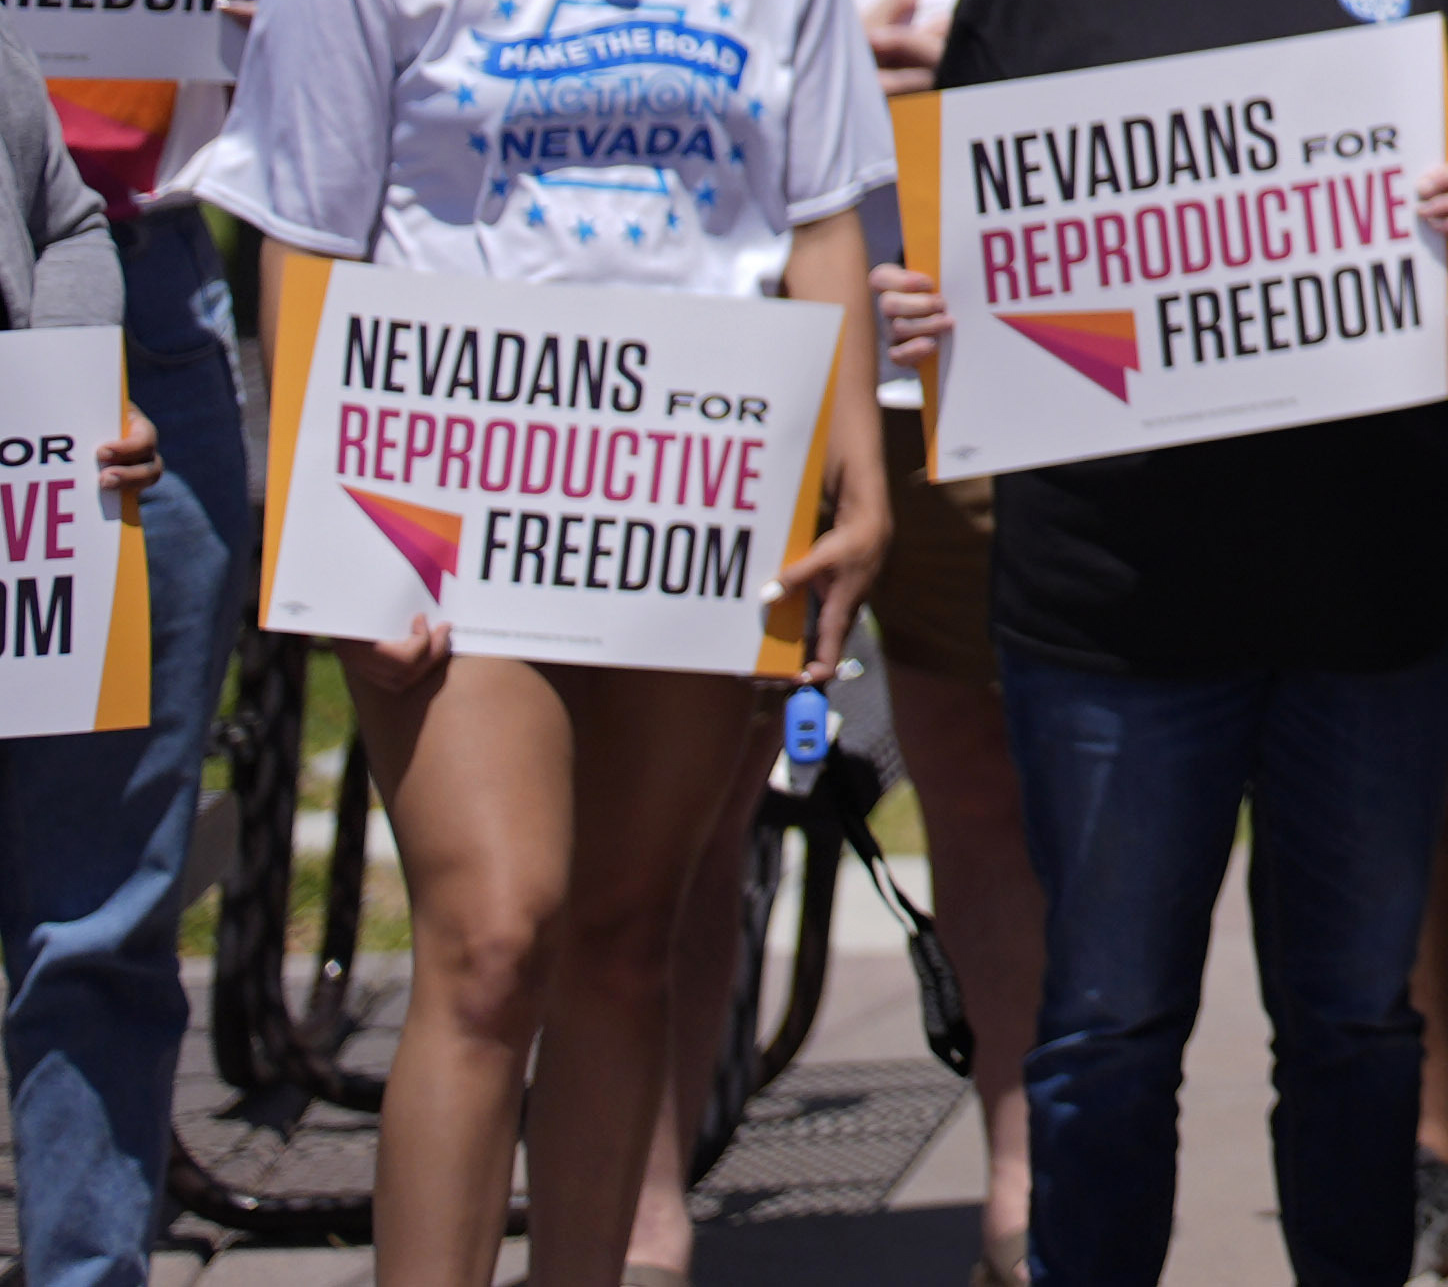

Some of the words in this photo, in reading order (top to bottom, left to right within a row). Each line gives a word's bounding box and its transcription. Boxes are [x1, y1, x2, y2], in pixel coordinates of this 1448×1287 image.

[499, 39, 590, 71] MAKE
[589, 27, 652, 59] THE
[655, 29, 741, 75] ROAD
[505, 74, 731, 121] ACTION
[501, 124, 715, 163] NEVADA
[970, 97, 1280, 215] NEVADANS
[1302, 125, 1400, 164] FOR
[980, 164, 1410, 304] REPRODUCTIVE
[1156, 256, 1424, 370] FREEDOM
[342, 315, 648, 413] NEVADANS
[666, 390, 772, 424] FOR
[336, 403, 765, 513] REPRODUCTIVE
[480, 509, 752, 601] FREEDOM
